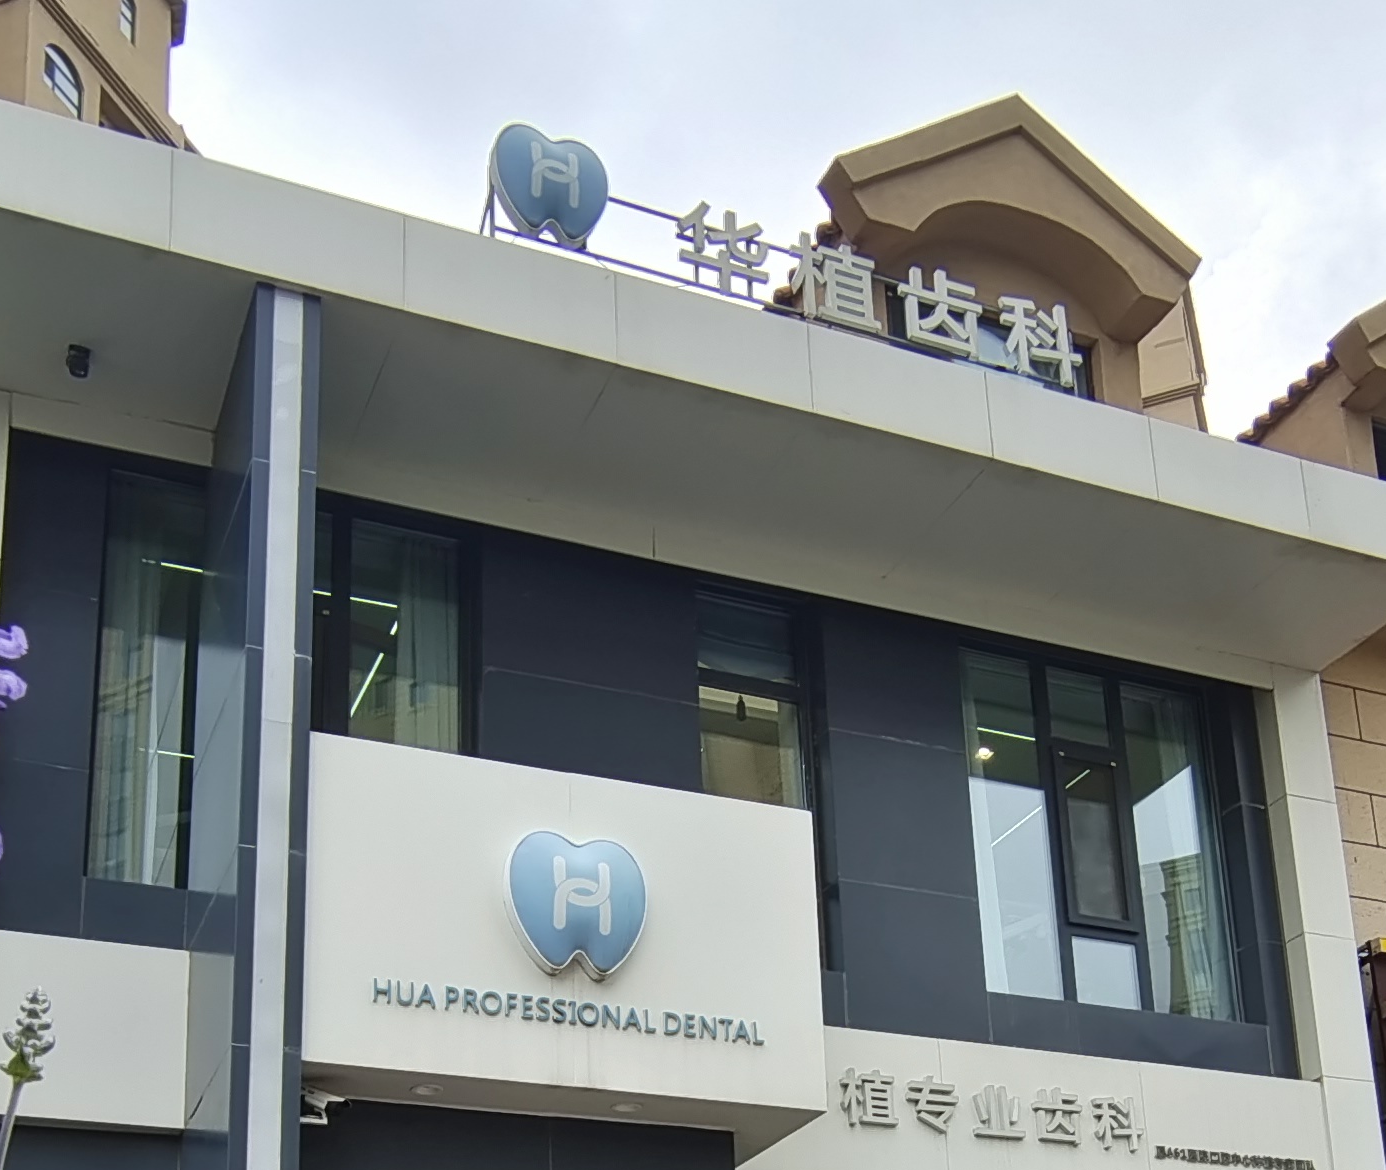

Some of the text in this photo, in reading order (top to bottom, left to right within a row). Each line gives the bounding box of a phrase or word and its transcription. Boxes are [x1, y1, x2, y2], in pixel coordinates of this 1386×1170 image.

[676, 201, 1082, 389] 华植齿科
[372, 977, 765, 1046] HUA PROFESSIONAL DENTAL
[839, 1067, 1145, 1153] 植专业齿科
